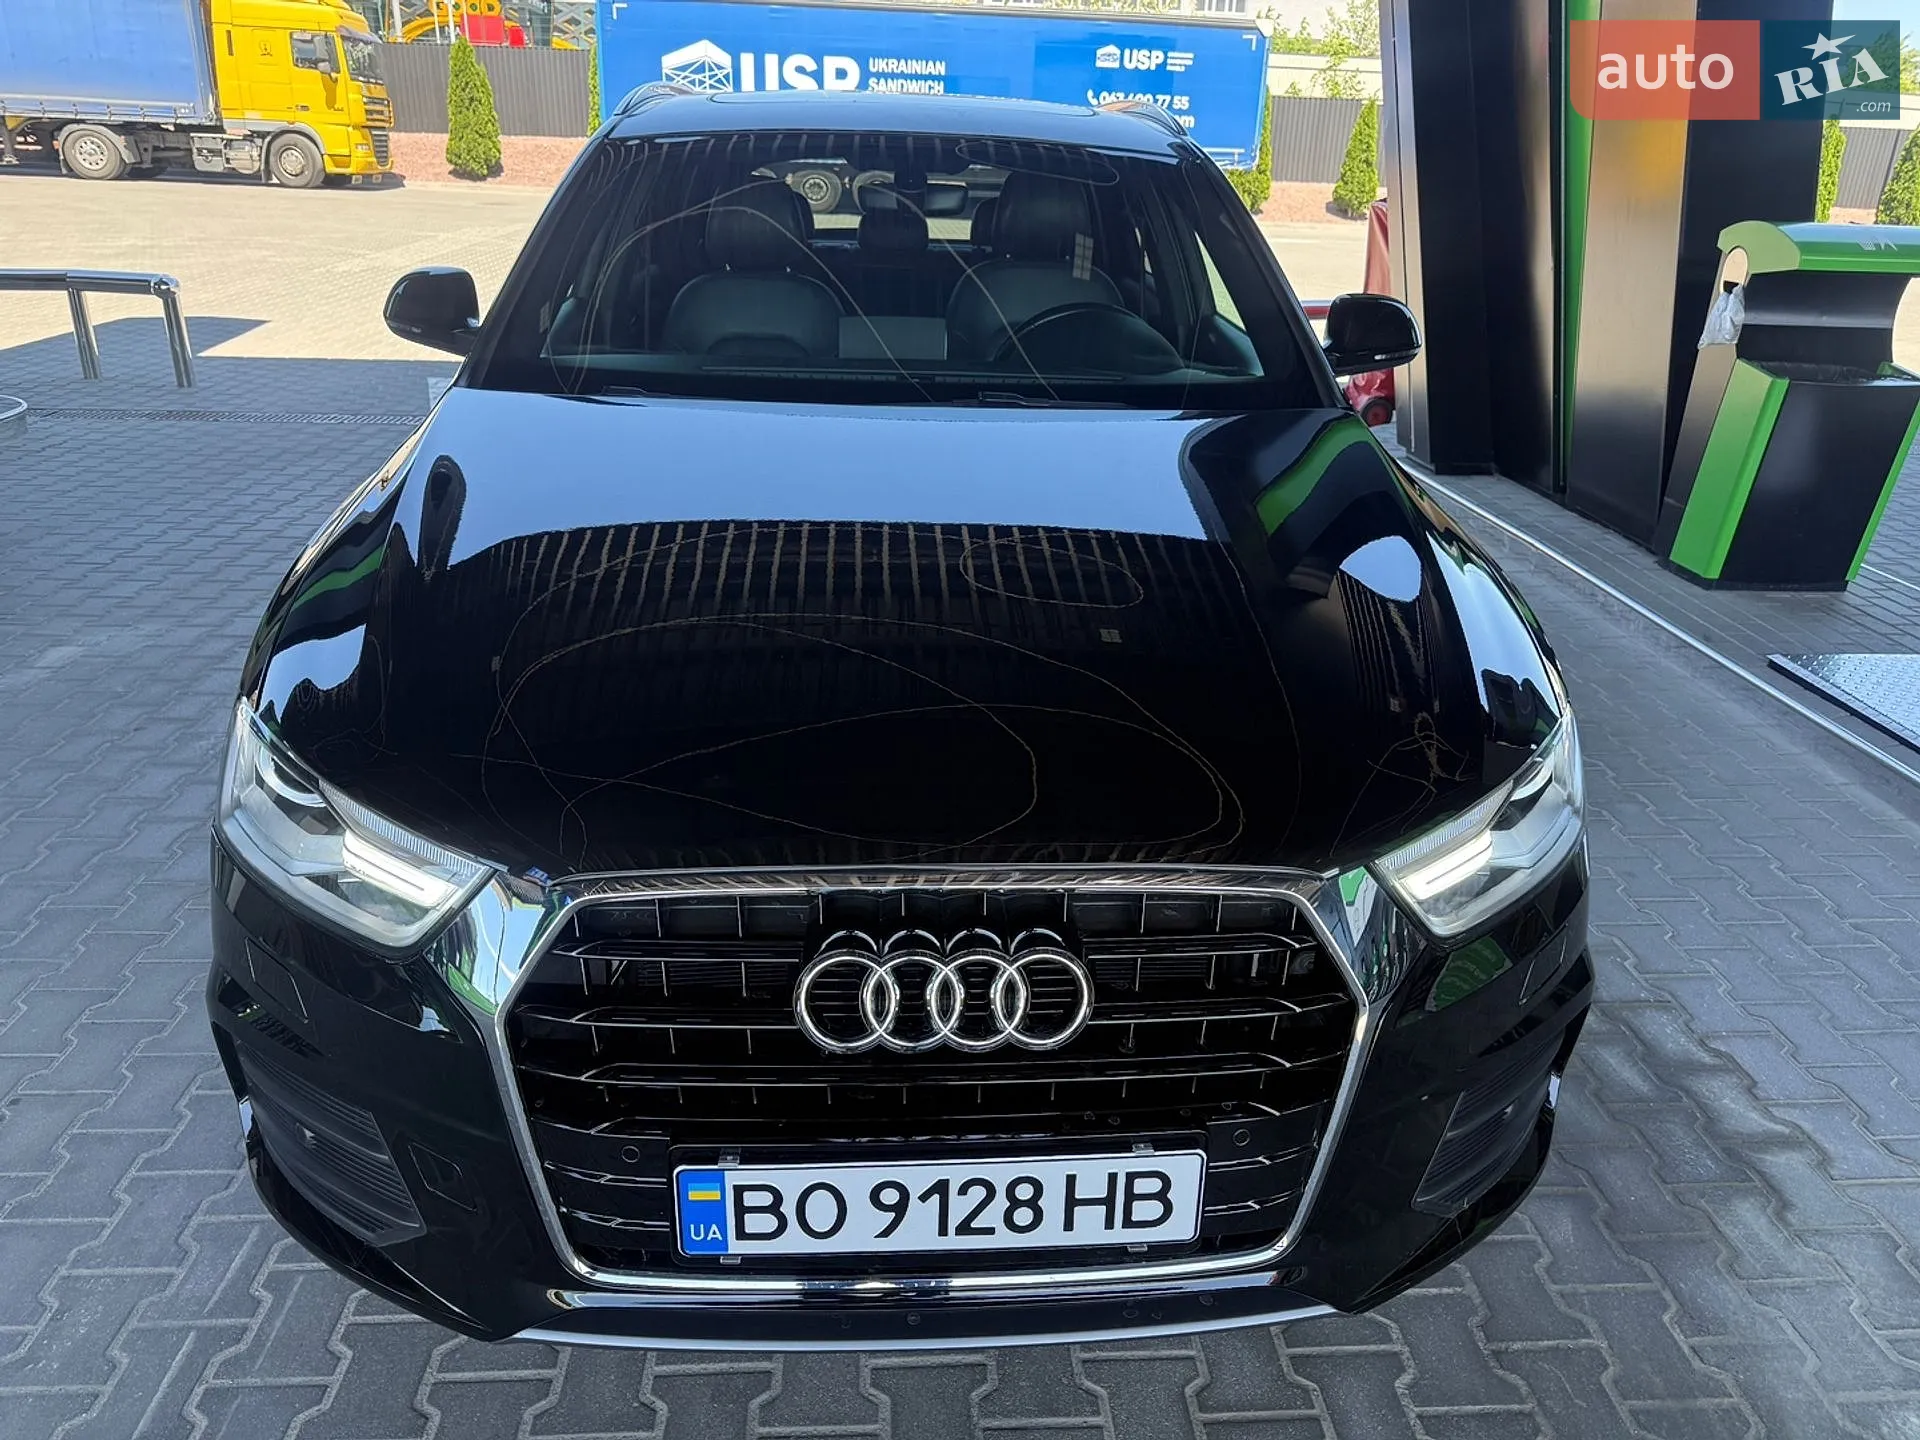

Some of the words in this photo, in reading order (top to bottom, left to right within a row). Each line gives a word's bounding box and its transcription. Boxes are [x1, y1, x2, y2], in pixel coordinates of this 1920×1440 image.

[868, 57, 945, 76] UKRAINIAN
[1123, 48, 1164, 71] USP
[740, 53, 860, 92] USP
[868, 77, 944, 95] SANDWICH
[1172, 95, 1189, 110] 55
[732, 1181, 848, 1241] BO
[869, 1175, 1044, 1239] 9128
[1062, 1169, 1174, 1232] HB
[690, 1224, 723, 1242] UA
